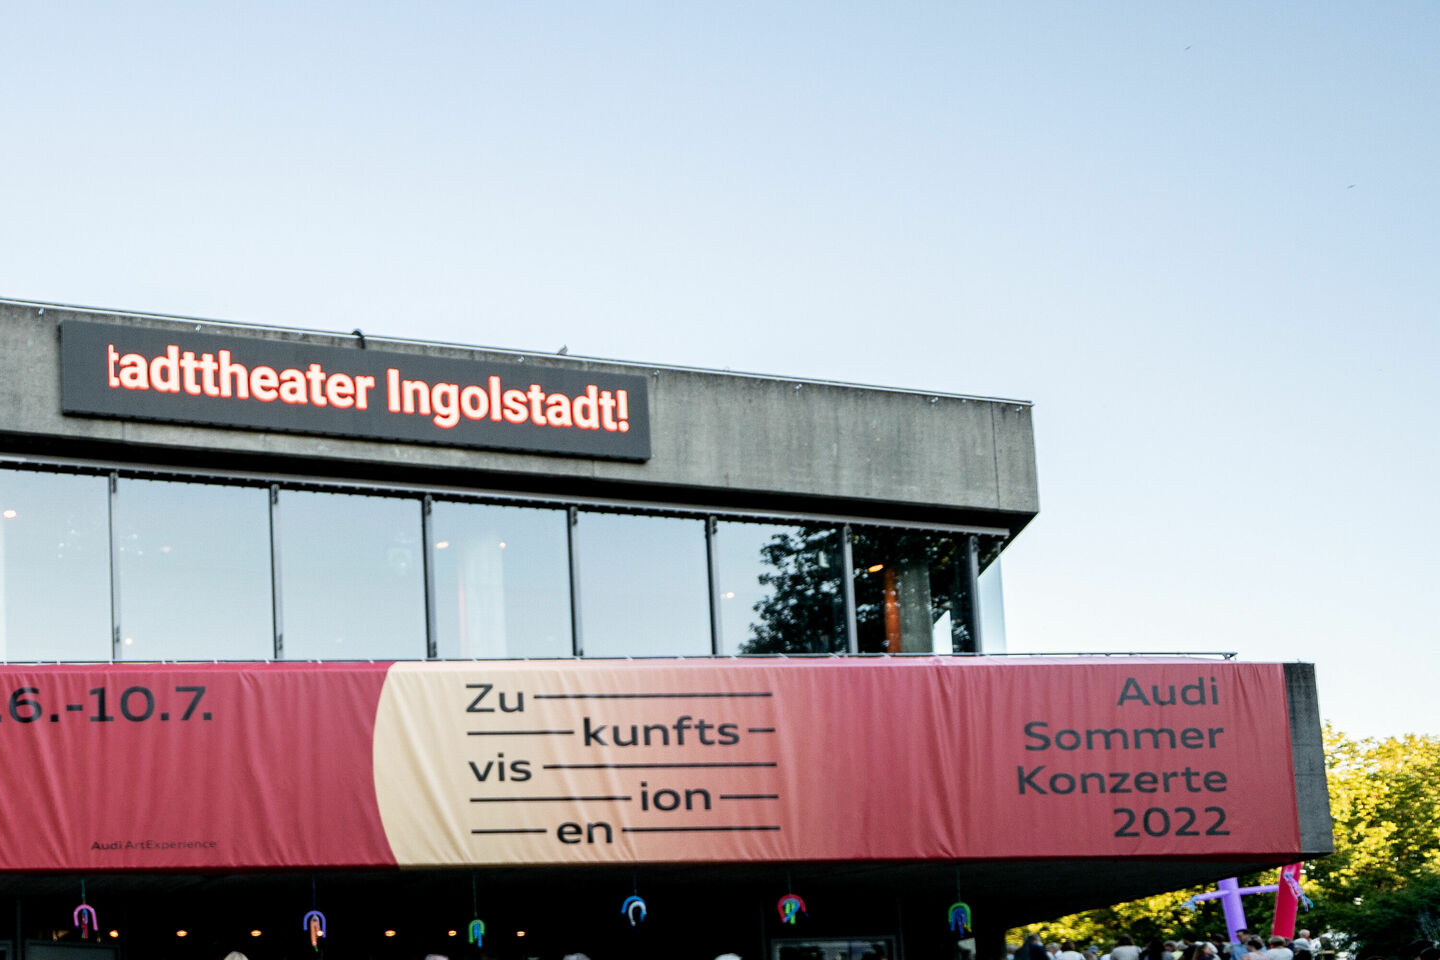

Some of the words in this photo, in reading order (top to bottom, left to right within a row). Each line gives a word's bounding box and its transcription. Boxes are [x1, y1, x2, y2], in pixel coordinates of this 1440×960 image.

[107, 343, 374, 410] tadttheater
[386, 368, 630, 433] Ingolstadt!
[465, 683, 524, 713] Zu
[1117, 676, 1219, 706] Audi
[583, 716, 740, 747] kunfts
[1024, 721, 1224, 751] Sommer
[469, 753, 532, 782] vis
[1017, 764, 1227, 795] Konzerte
[641, 781, 712, 811] ion
[556, 820, 613, 844] en
[1113, 806, 1230, 837] 2022
[90, 841, 122, 850] Audi
[125, 840, 217, 850] ArtExperience
